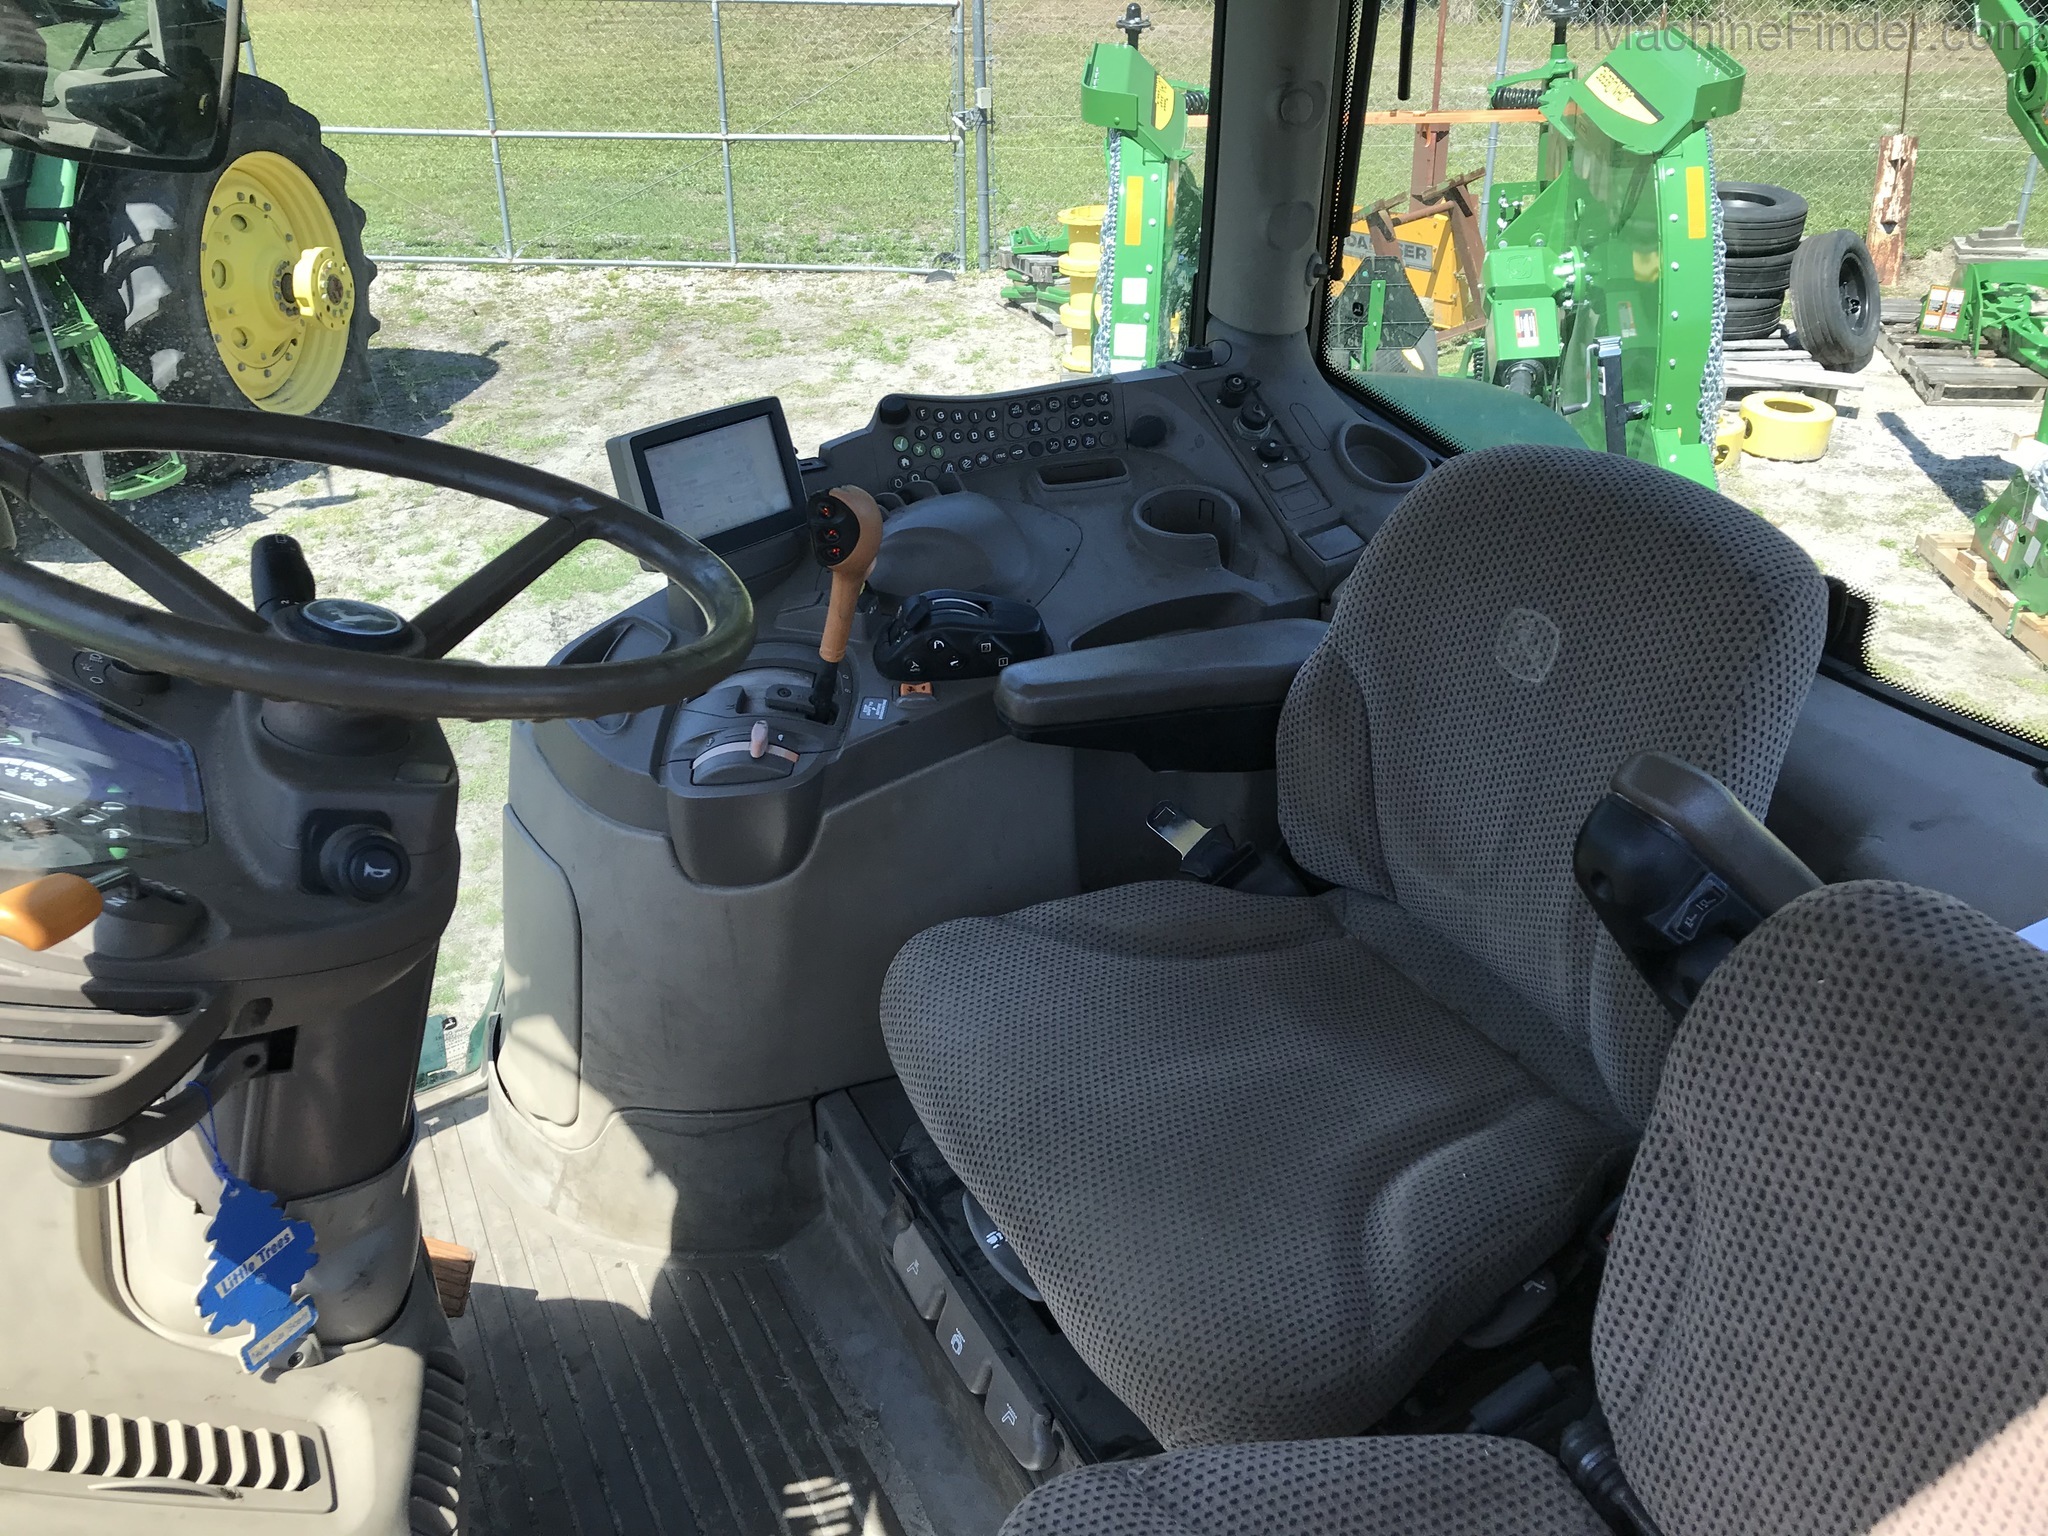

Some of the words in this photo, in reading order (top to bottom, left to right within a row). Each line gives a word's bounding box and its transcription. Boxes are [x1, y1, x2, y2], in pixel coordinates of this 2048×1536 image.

[920, 409, 926, 417] F
[937, 411, 945, 419] G
[955, 412, 962, 421] H
[919, 429, 926, 437] A
[936, 431, 943, 439] B
[954, 432, 961, 440] C
[971, 432, 978, 440] D
[989, 430, 996, 438] E
[221, 1261, 256, 1294] Little
[255, 1232, 292, 1264] Trees
